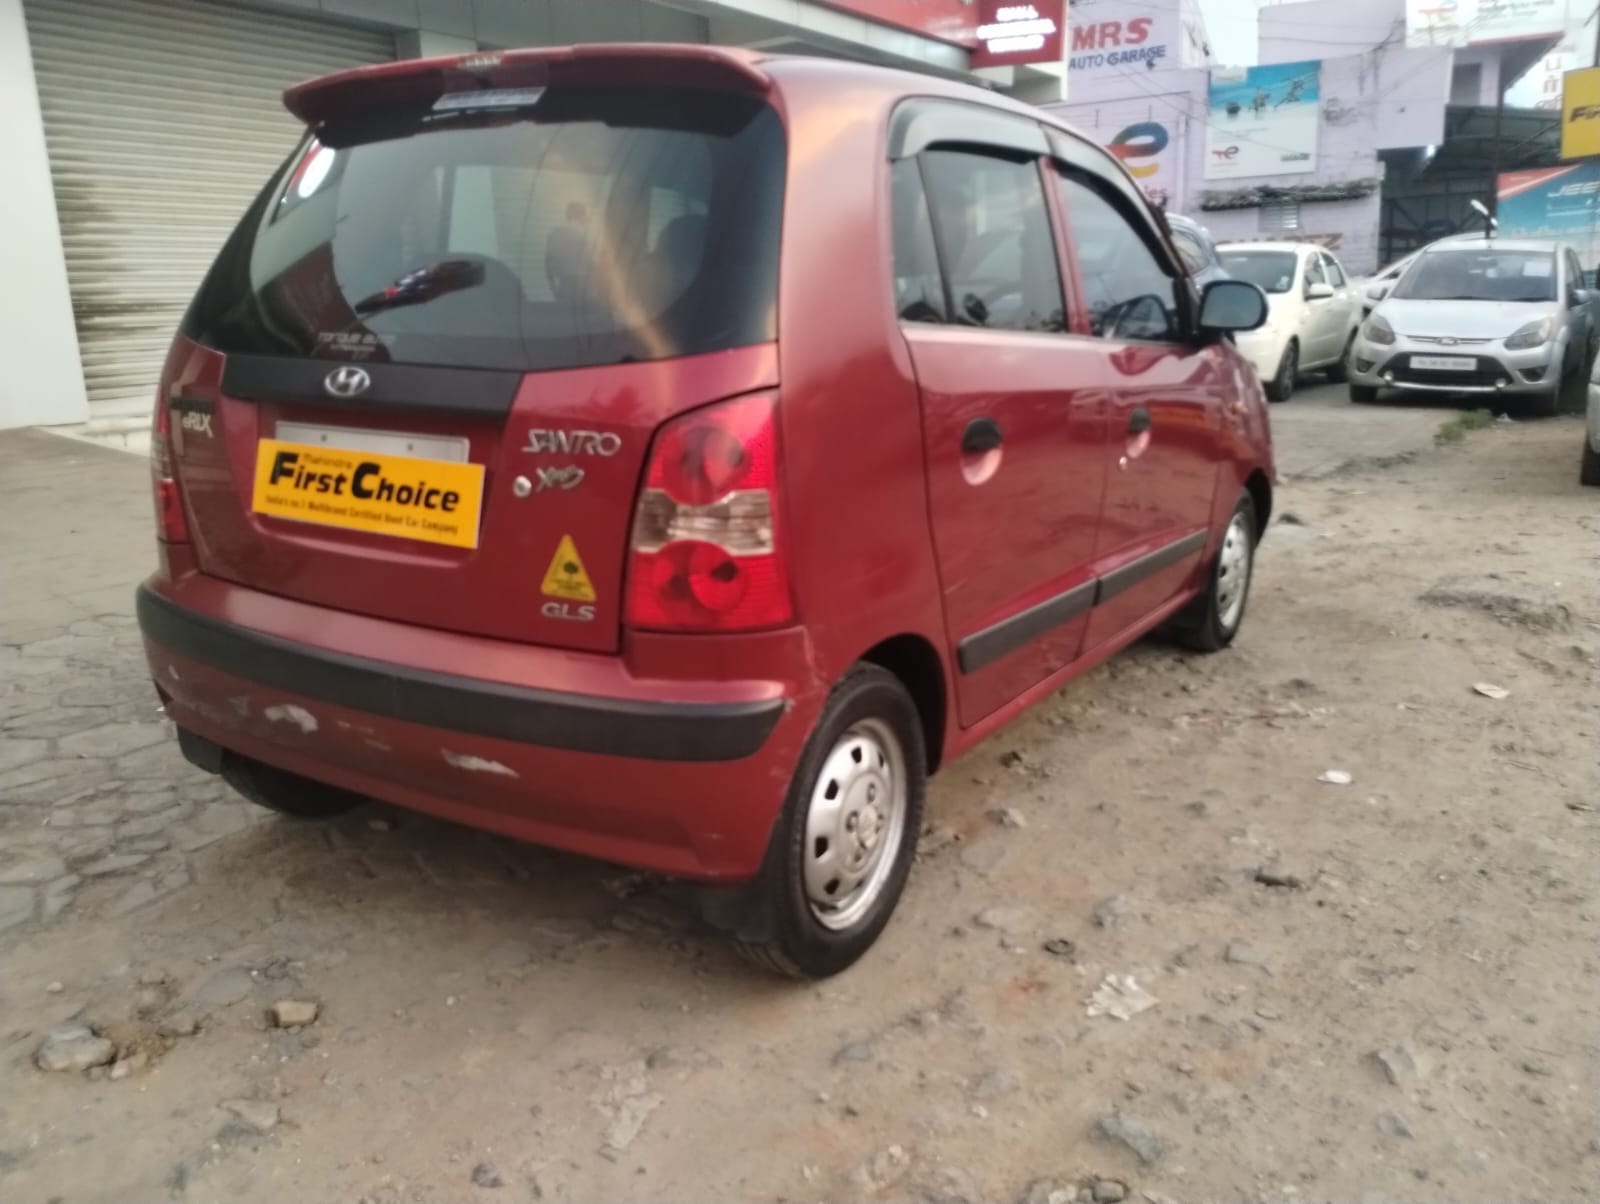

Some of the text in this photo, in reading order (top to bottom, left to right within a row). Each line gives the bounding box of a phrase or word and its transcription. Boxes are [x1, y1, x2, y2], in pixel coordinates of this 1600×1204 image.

[1072, 17, 1153, 51] MRS
[1068, 45, 1167, 71] AUTO GARAGE
[521, 428, 622, 457] SANTRO
[269, 450, 460, 513] First Choice
[540, 602, 596, 621] GLS
